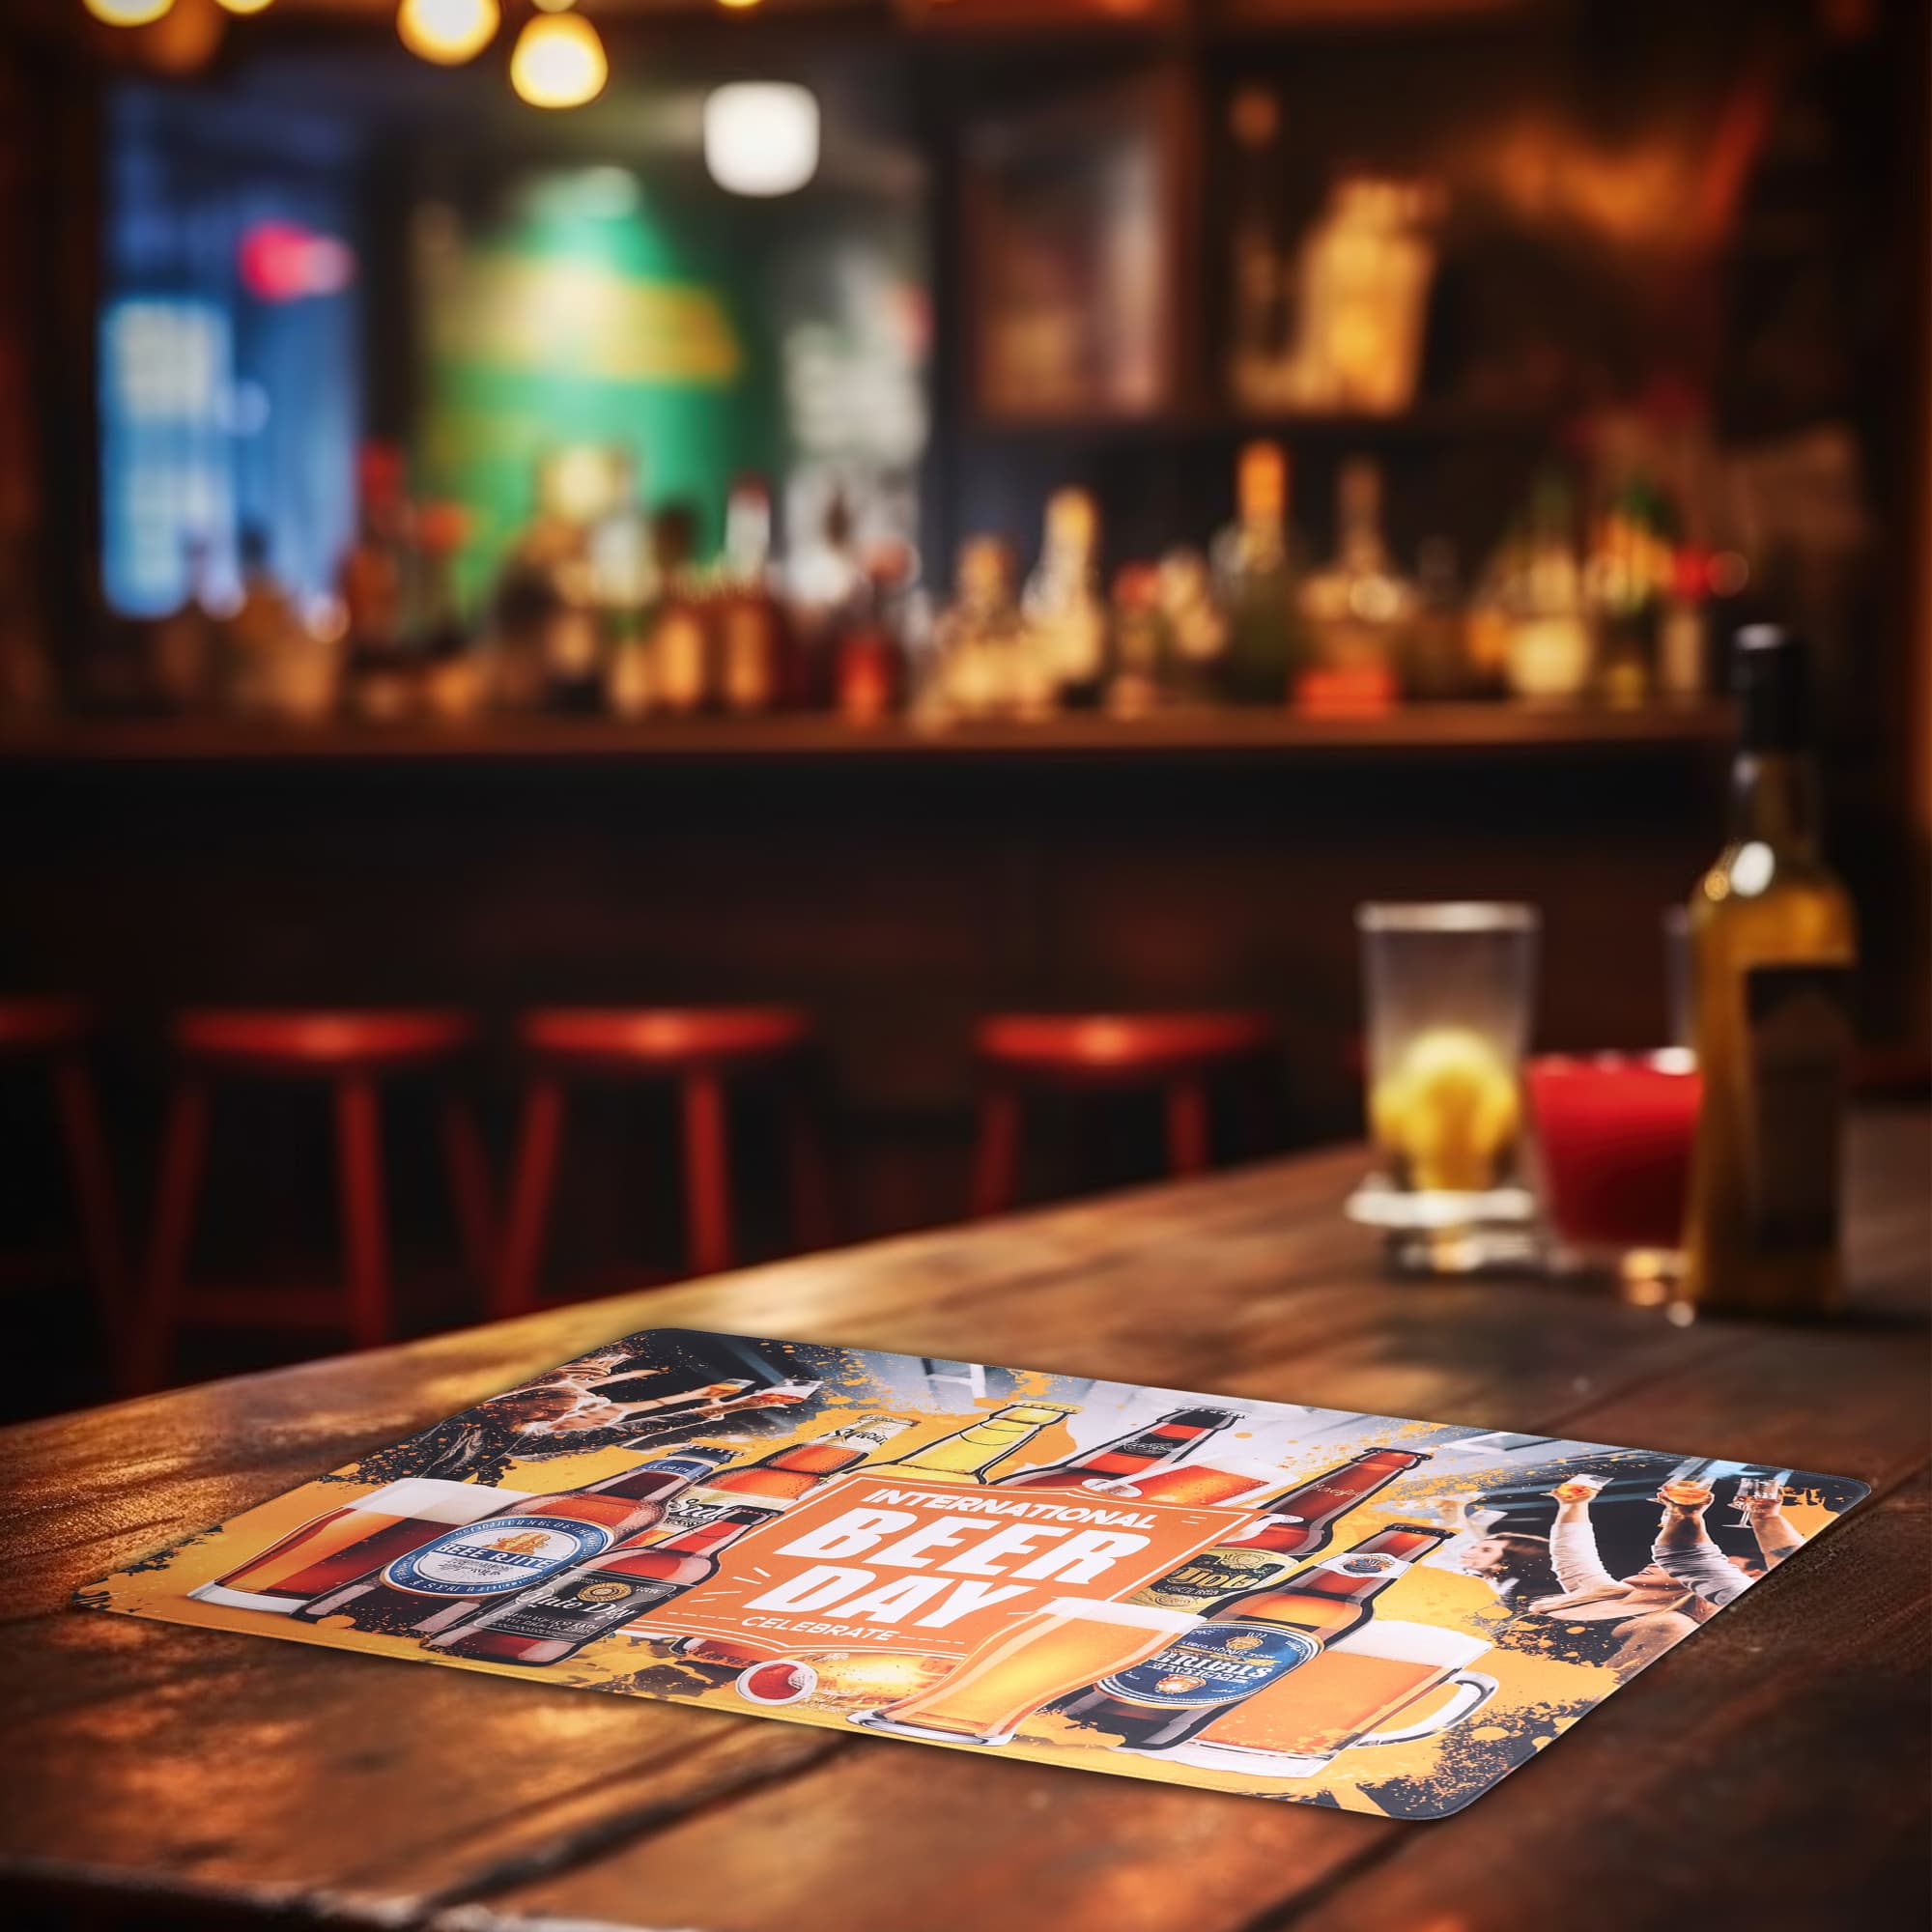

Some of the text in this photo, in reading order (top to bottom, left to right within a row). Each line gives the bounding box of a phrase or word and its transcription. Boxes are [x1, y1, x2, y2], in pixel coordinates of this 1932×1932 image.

[862, 1489, 1156, 1529] INTERNATIONAL
[774, 1507, 1151, 1585] BEER
[741, 1565, 1038, 1629] DAY
[741, 1616, 900, 1641] CELEBRATE
